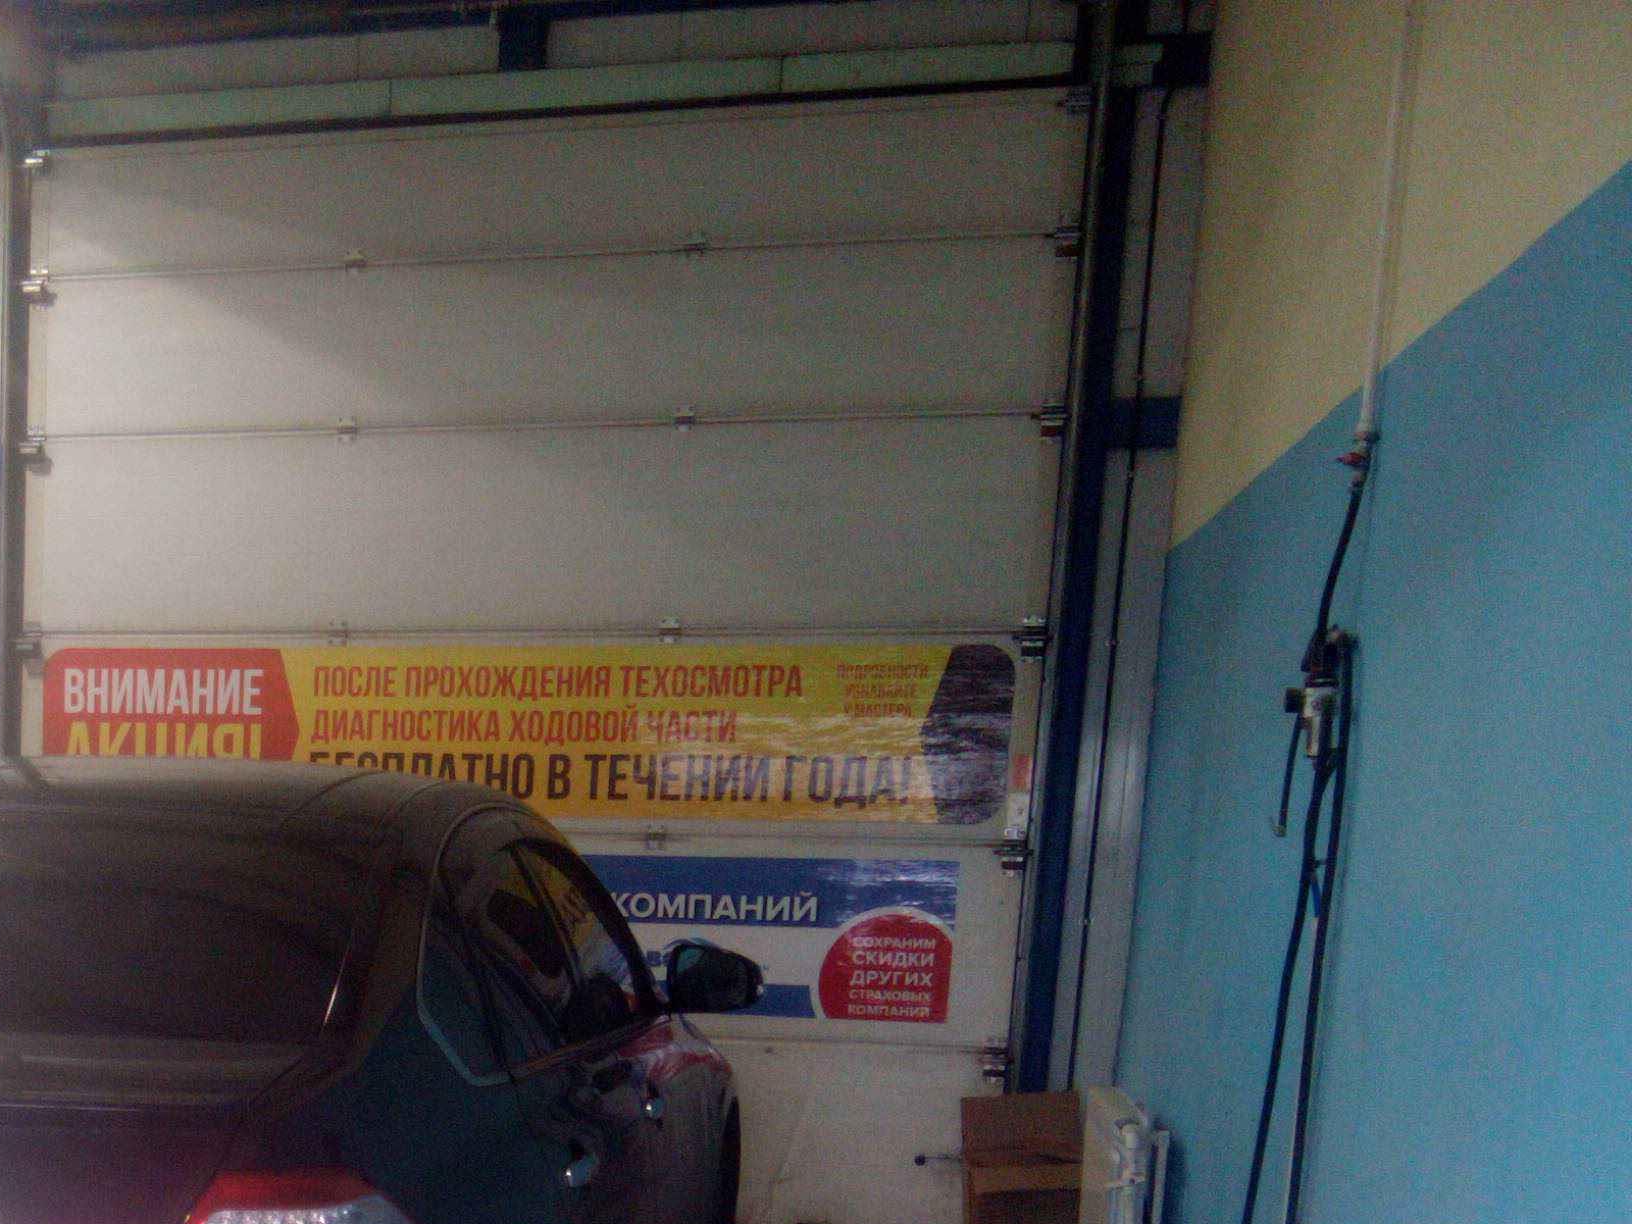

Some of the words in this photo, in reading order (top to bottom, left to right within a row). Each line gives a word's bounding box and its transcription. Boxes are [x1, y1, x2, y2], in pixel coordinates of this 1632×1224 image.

[64, 668, 264, 715] ВНИМАНИЕ
[313, 665, 398, 698] ПОСЛЕ
[404, 664, 611, 701] ПРОХОЖДЕНИЯ
[621, 664, 803, 698] ТЕХОСМОТРА
[310, 709, 501, 744] ДИАГНОСТИКА
[508, 704, 638, 746] ХОДОВОЙ
[647, 710, 738, 744] ЧАСТИ
[547, 753, 572, 801] В
[584, 754, 770, 802] ТЕЧЕНИИ
[784, 755, 912, 809] ГОДА!
[613, 891, 818, 922] КОМПАНИЙ
[851, 935, 937, 951] СОХРАНИМ
[851, 951, 936, 968] СКИДКИ
[849, 970, 934, 987] ДРУГИХ
[848, 988, 932, 1002] СТРАХОВЫХ
